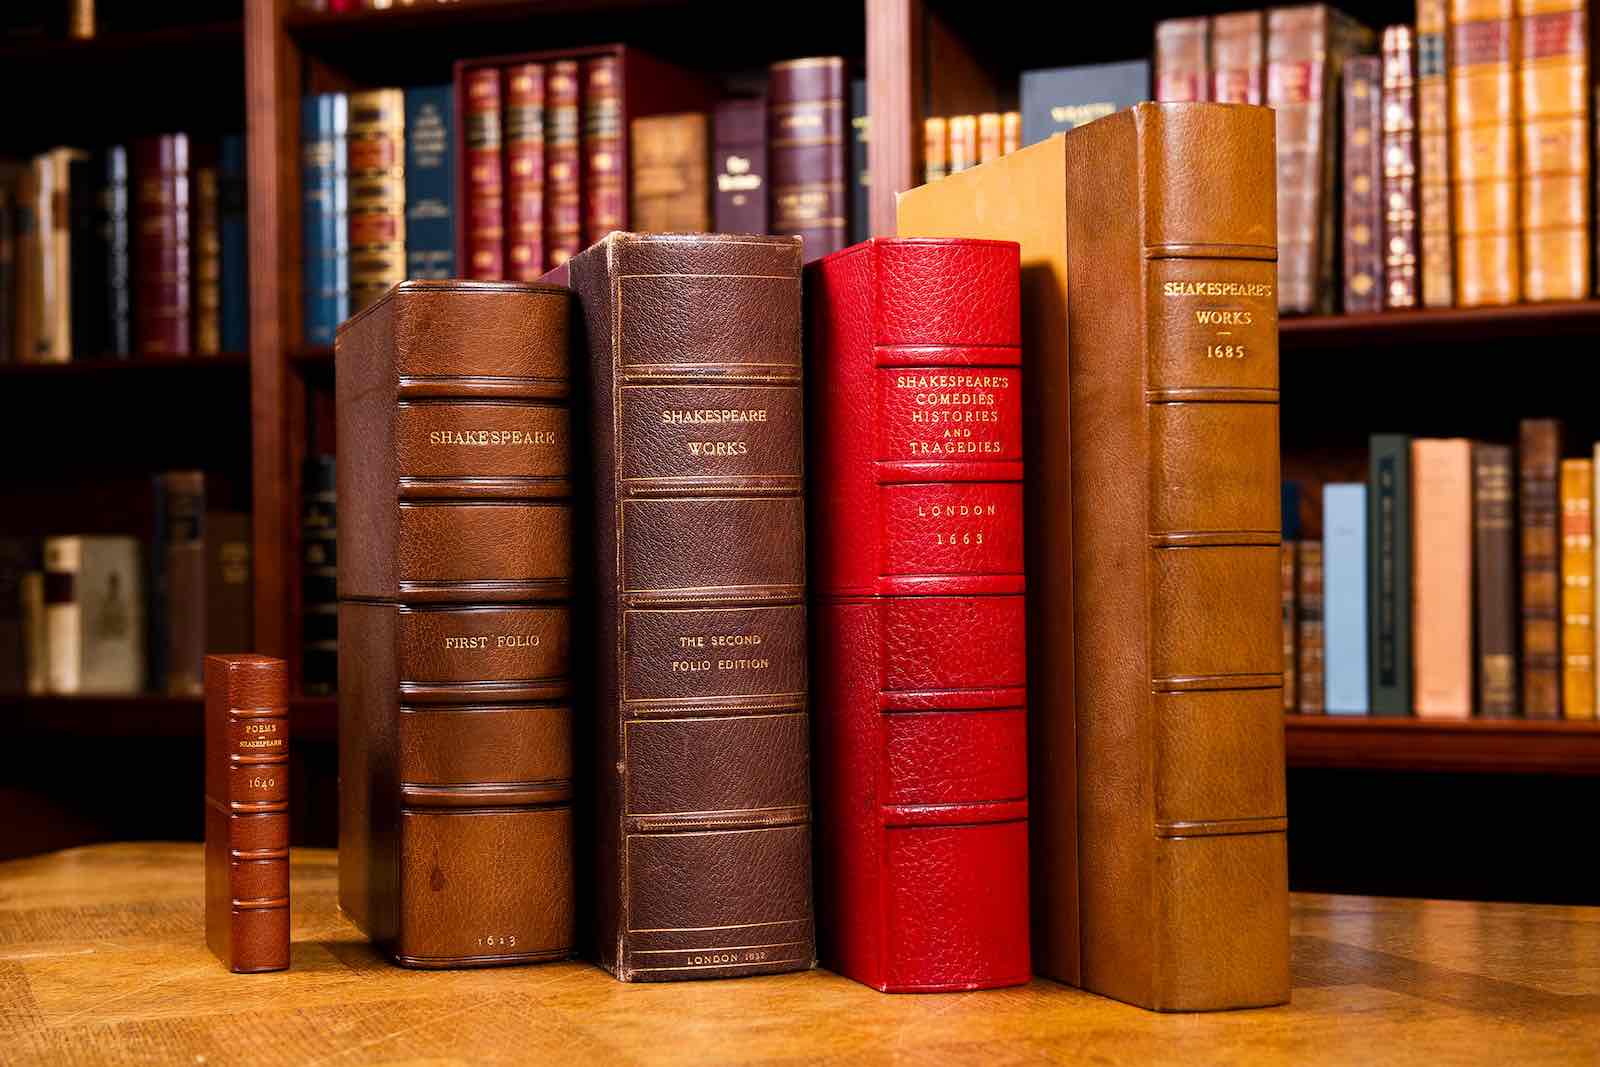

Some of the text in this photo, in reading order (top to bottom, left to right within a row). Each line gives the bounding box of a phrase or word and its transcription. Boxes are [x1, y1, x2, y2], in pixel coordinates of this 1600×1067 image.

[1196, 311, 1252, 325] WORKS
[1207, 345, 1245, 358] 1685
[897, 375, 1009, 388] SHAKESPEARE'S
[916, 393, 994, 405] COMEDIES
[662, 409, 767, 423] SHAKESPEARE
[912, 410, 998, 423] HISTORIES
[430, 430, 555, 445] SHAKESPEARE
[943, 428, 971, 438] AND
[688, 441, 748, 456] WORKS
[909, 441, 1001, 454] TRAGEDIES
[918, 505, 995, 517] LONDON
[937, 532, 983, 545] 1663
[445, 634, 540, 649] FIRST FOLIO
[680, 634, 761, 647] THE SECOND
[672, 658, 769, 671] FOLIO EDITION
[245, 724, 277, 733] POEMS
[687, 954, 738, 966] LONDON
